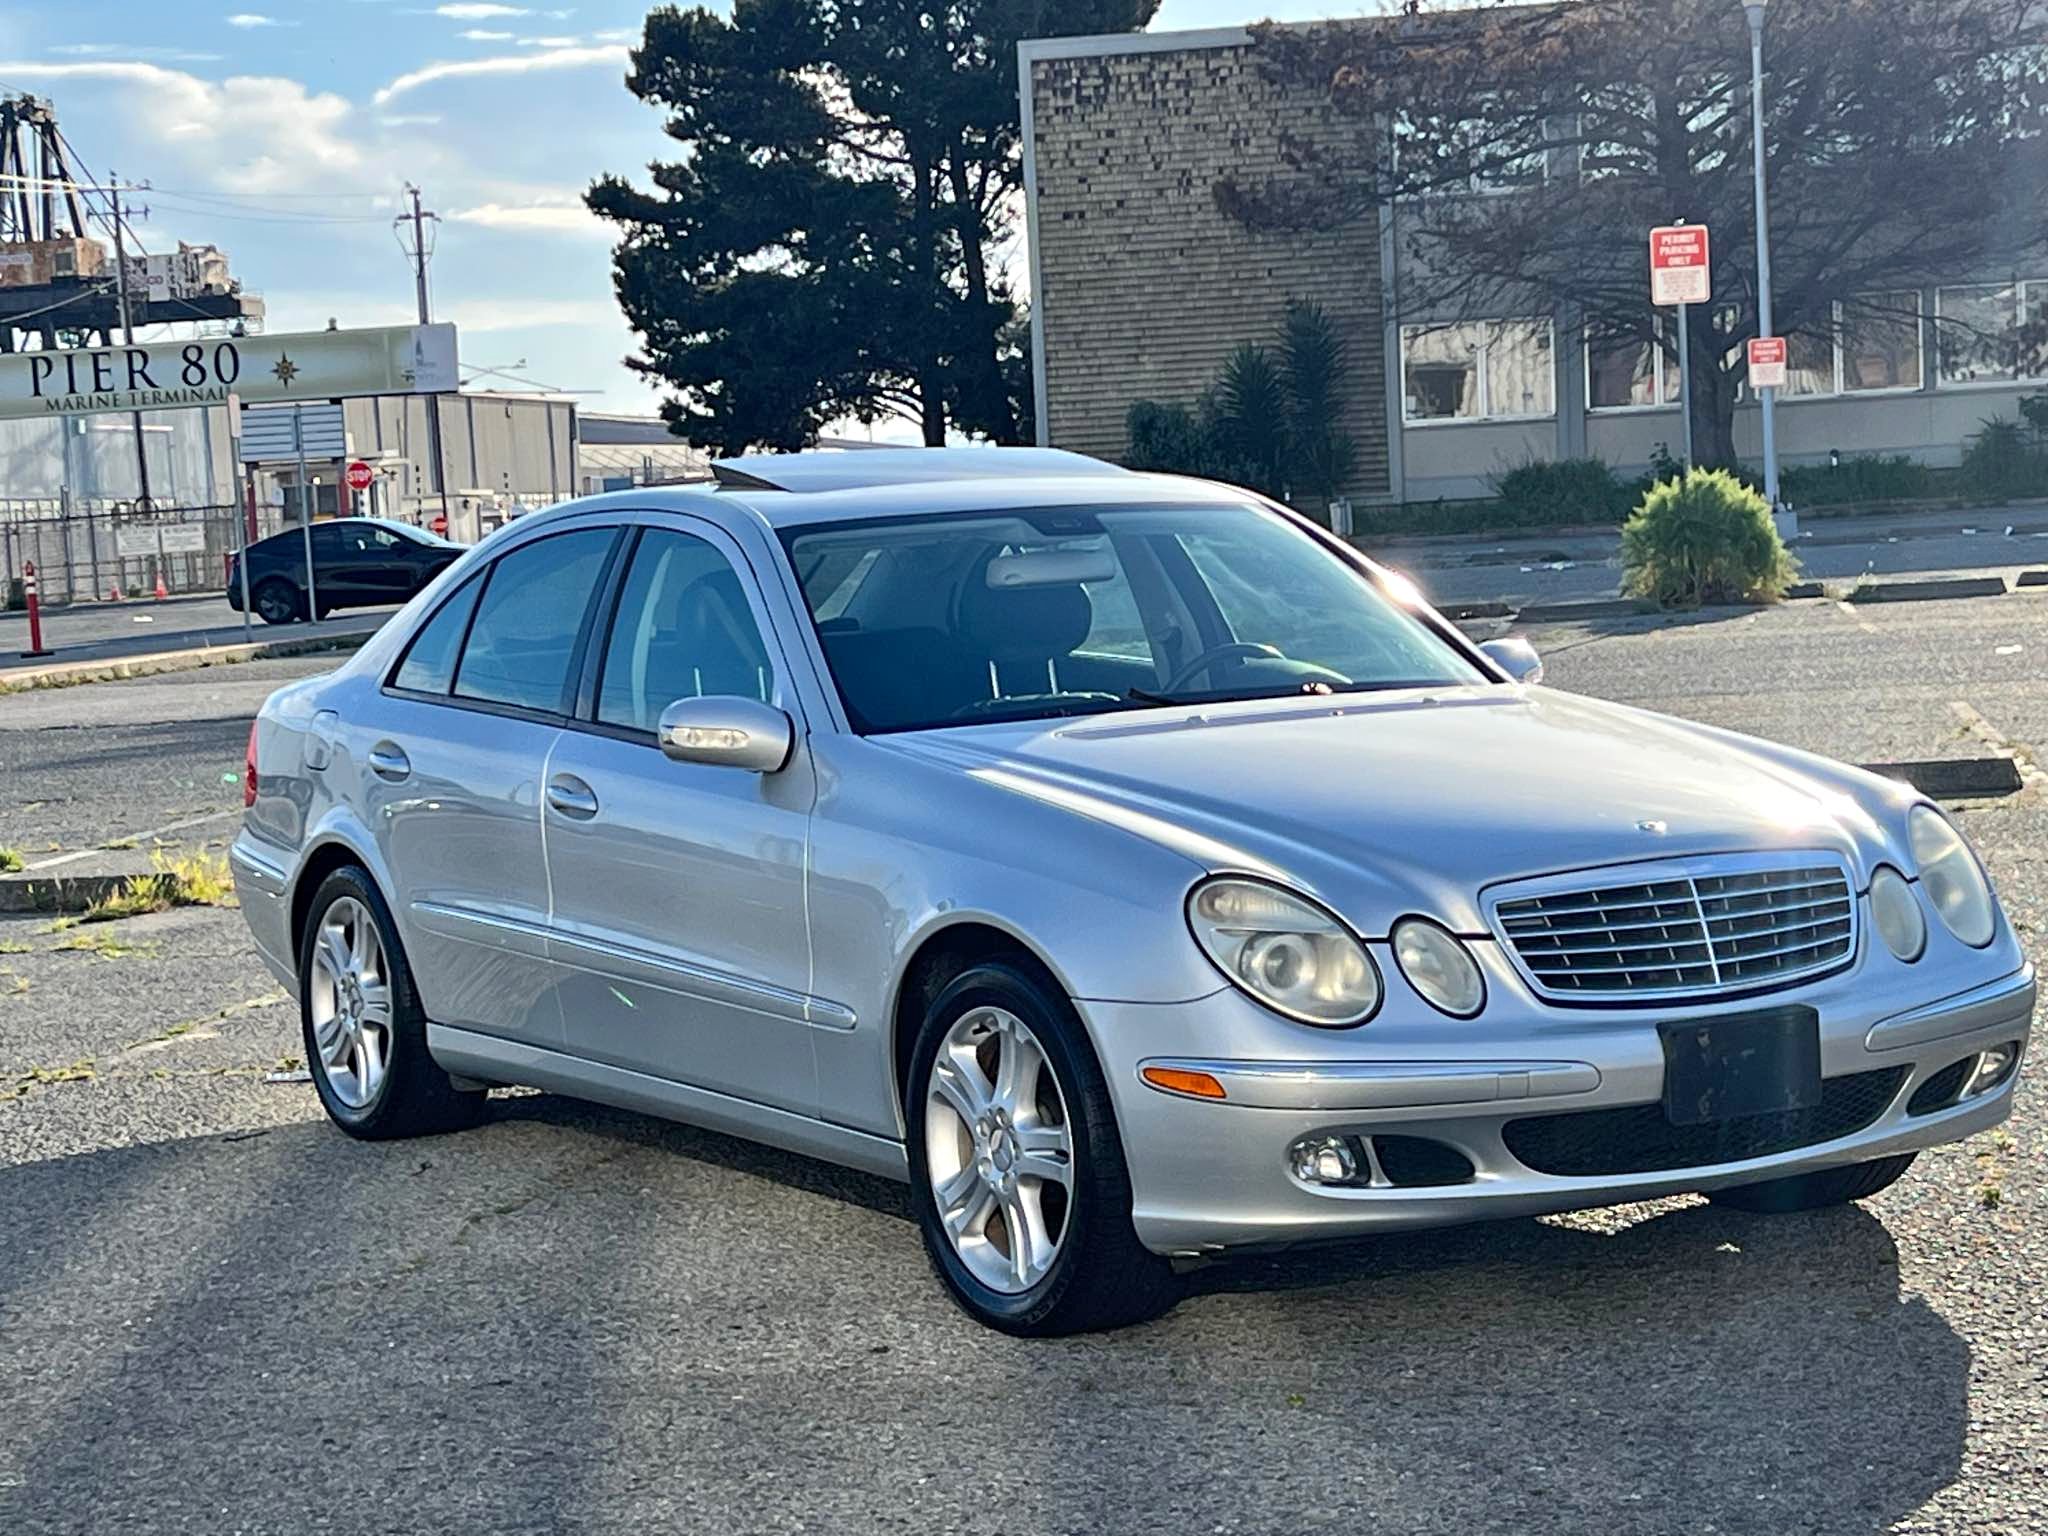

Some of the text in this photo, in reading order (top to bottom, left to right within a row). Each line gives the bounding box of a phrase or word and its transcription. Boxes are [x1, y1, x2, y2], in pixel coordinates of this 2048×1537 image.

[1659, 244, 1700, 256] PARKING
[28, 342, 240, 397] PIER 80
[45, 386, 229, 411] MARINE TERMINAL
[347, 470, 371, 482] STOP
